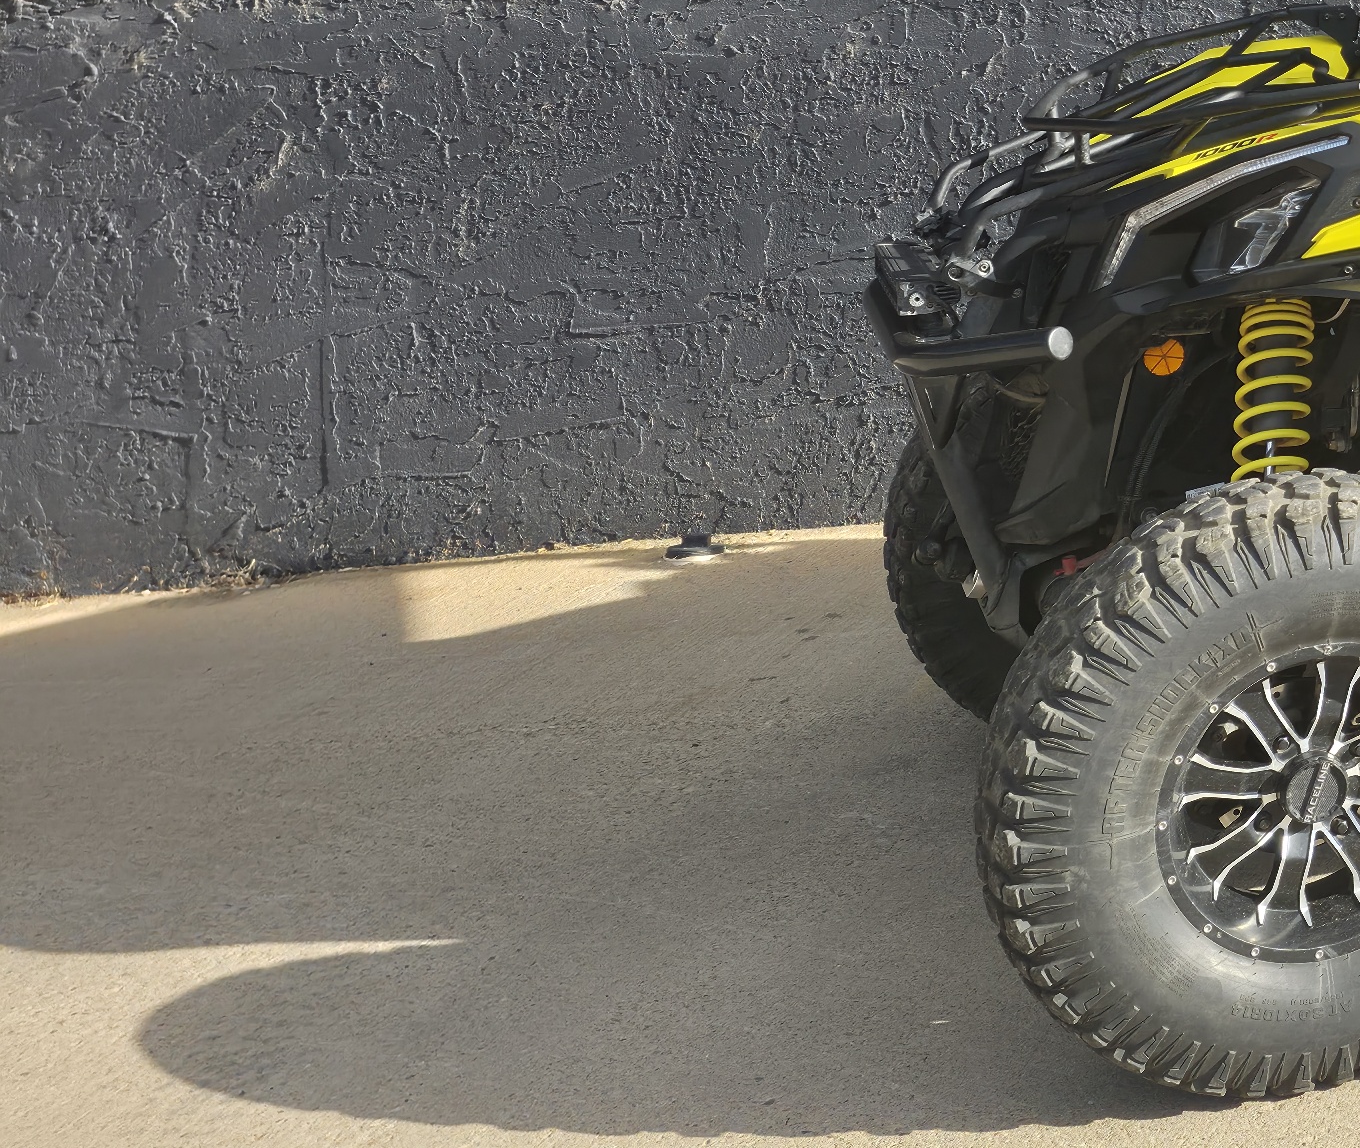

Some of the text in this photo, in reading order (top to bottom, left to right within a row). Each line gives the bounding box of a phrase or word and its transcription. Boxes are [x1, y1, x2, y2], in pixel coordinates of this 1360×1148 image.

[1191, 133, 1279, 161] 1000R
[1101, 654, 1214, 835] AFTERSHOCK
[1303, 760, 1331, 823] RACELINE
